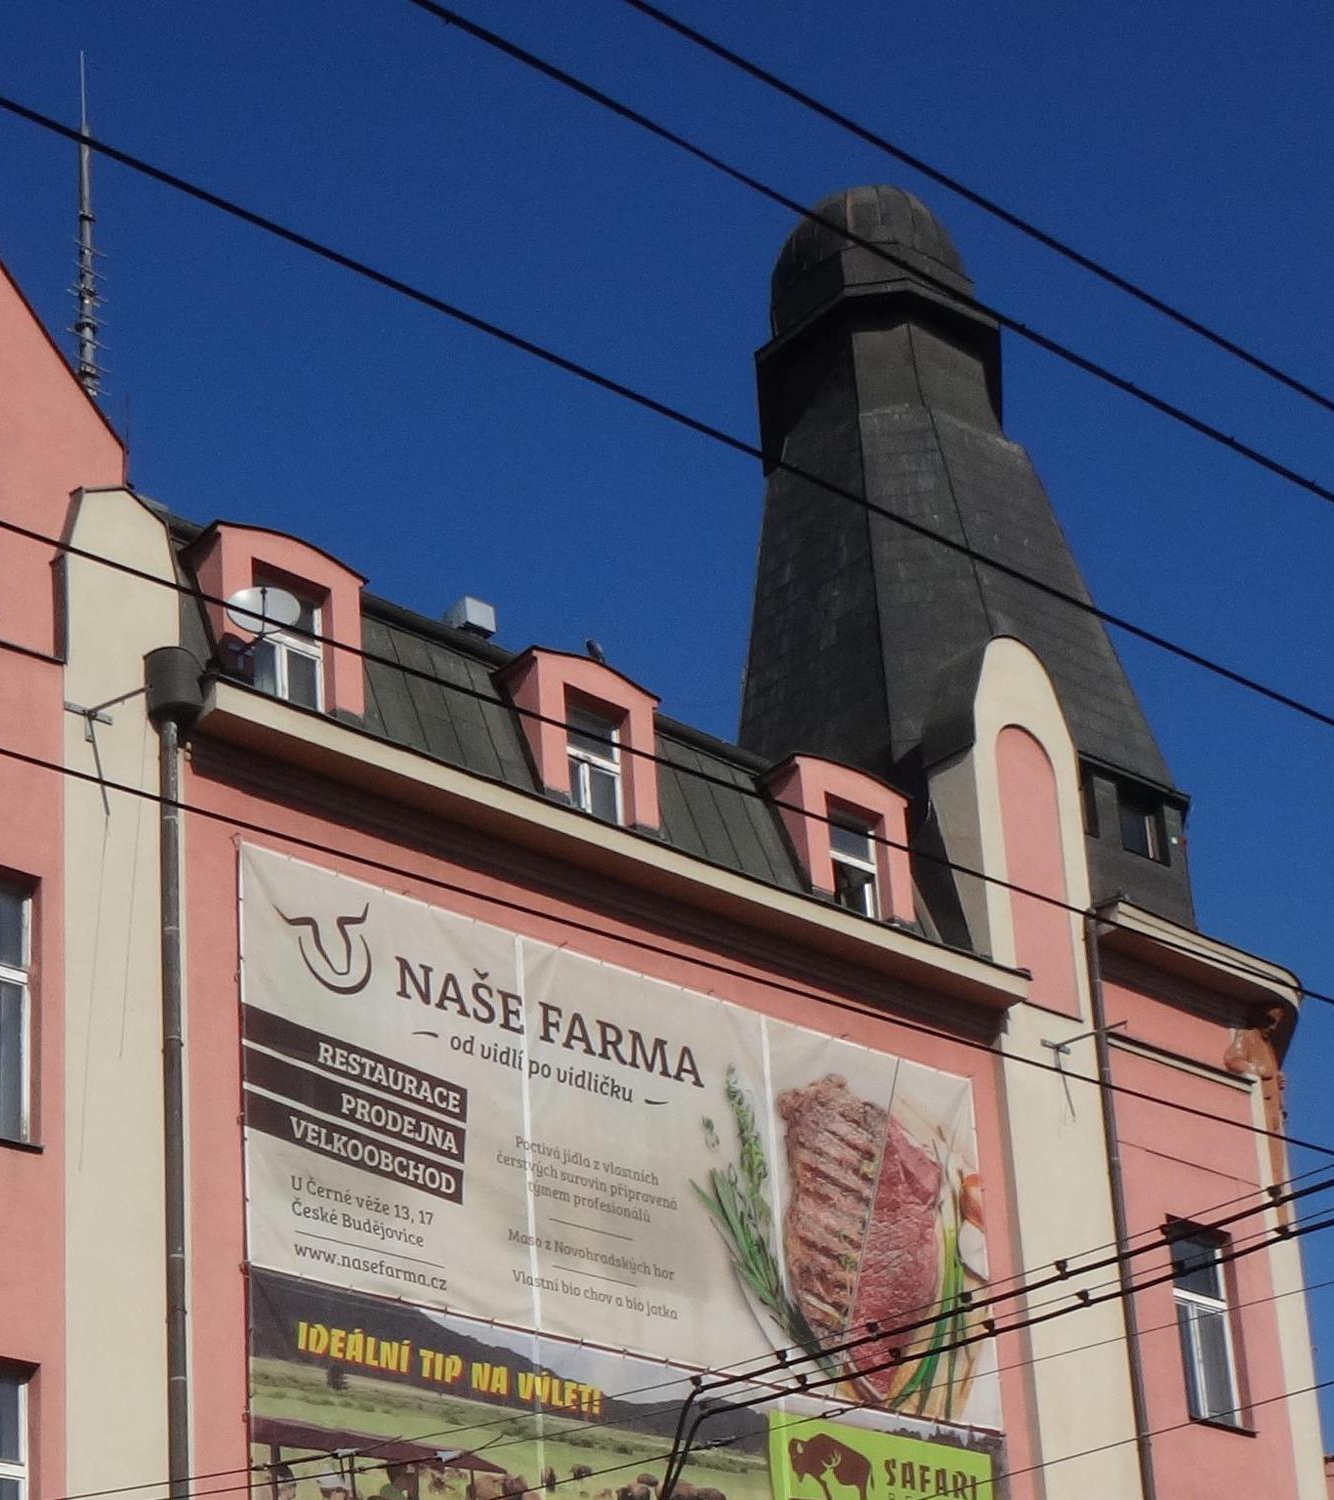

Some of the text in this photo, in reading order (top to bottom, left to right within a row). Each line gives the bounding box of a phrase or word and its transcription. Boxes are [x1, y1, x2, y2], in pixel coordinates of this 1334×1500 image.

[395, 956, 705, 1089] NAŠE FARMA
[318, 1042, 461, 1114] RESTAURACE
[450, 1035, 633, 1102] od vidlí po vidličku
[341, 1093, 459, 1155] PRODEJNA
[289, 1115, 456, 1194] VELKOOBCHOD
[497, 1150, 558, 1179] čerstvých
[561, 1170, 607, 1192] surovin
[515, 1136, 659, 1186] Poctivá jídla z vlastních
[291, 1175, 433, 1225] U Černé věže 13, 17
[292, 1201, 424, 1247] České Budějovice
[529, 1180, 651, 1223] týmem profesionálů
[294, 1243, 447, 1291] www.nasefarma.cz
[508, 1229, 675, 1281] Maso z Novohradských hor
[512, 1269, 678, 1320] Vlastní bio chov a bio jatka
[297, 1321, 603, 1415] IDEÁLNÍ TIP NA VÝLET!
